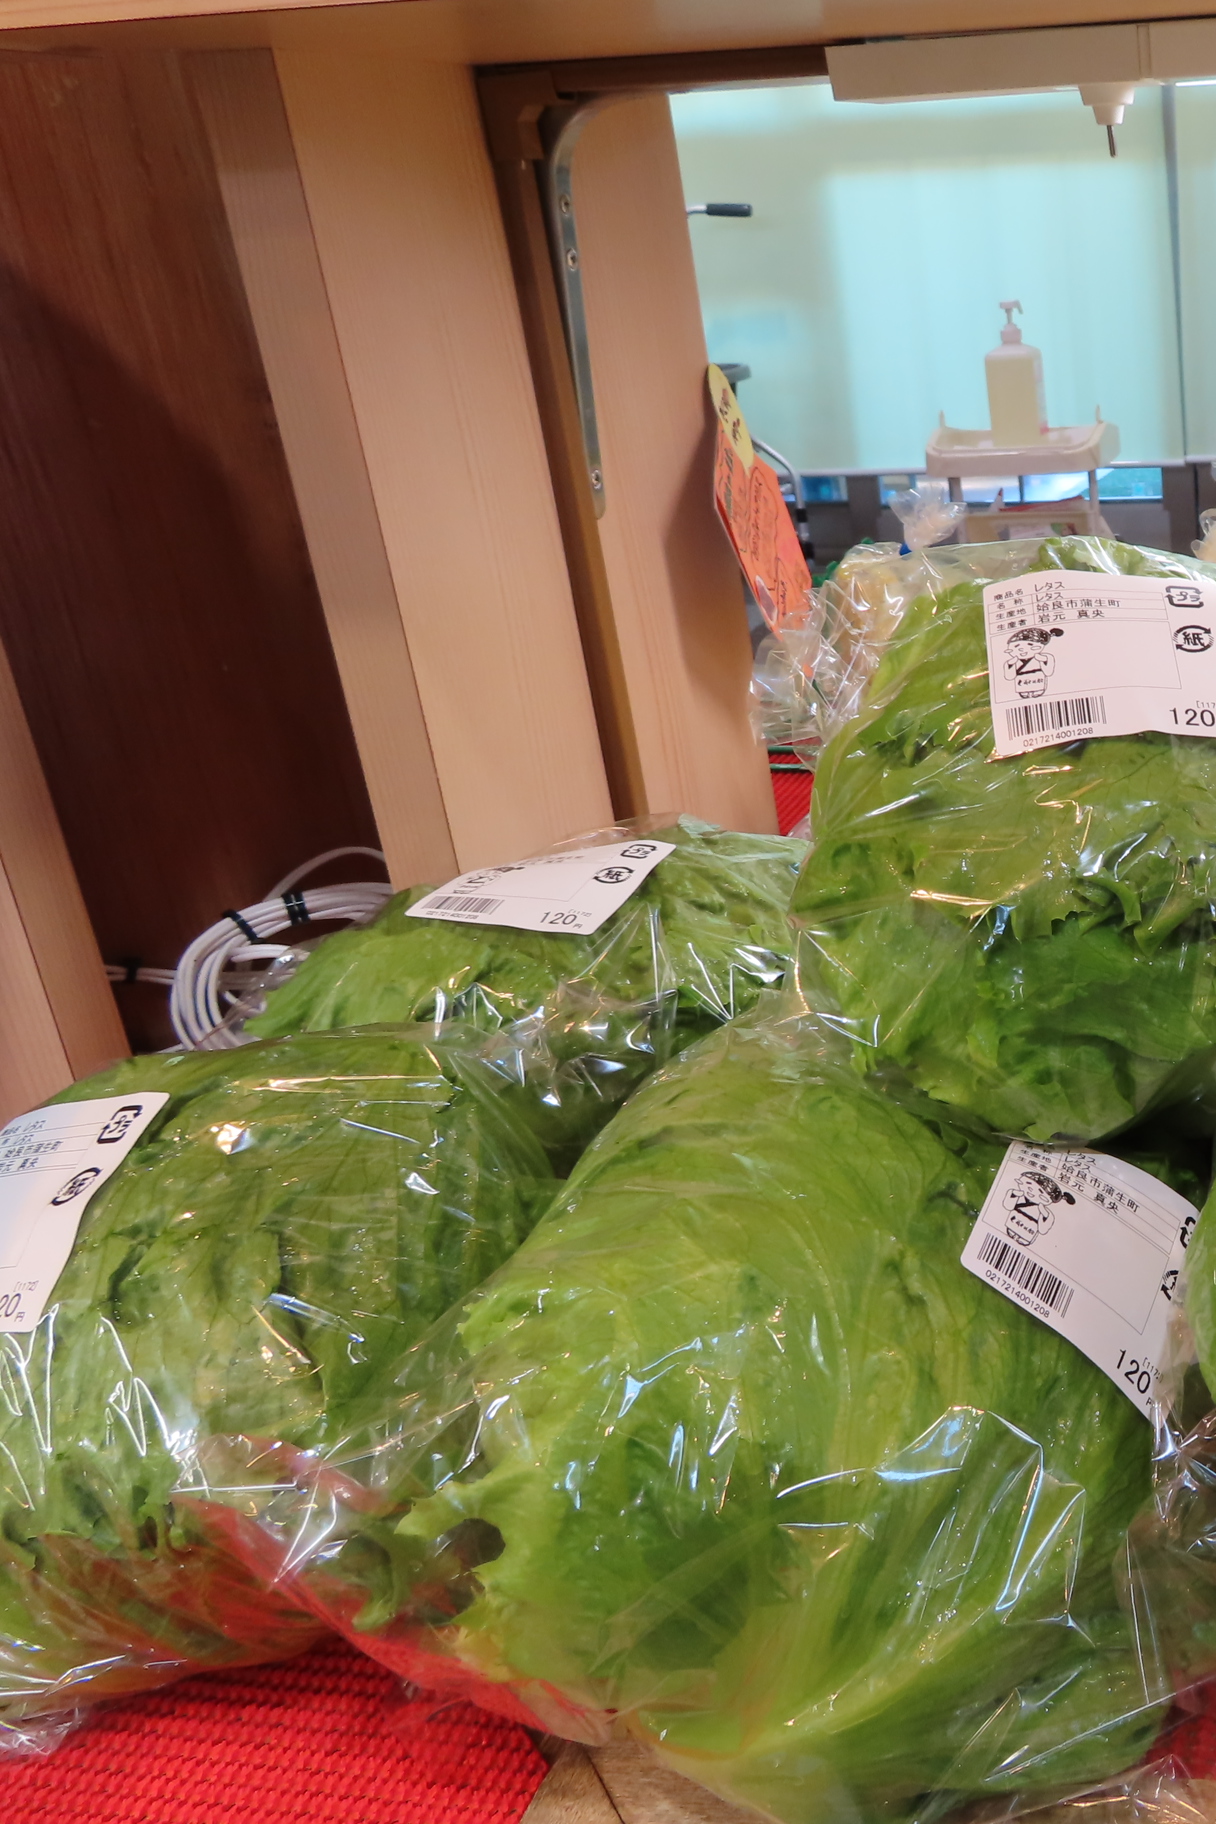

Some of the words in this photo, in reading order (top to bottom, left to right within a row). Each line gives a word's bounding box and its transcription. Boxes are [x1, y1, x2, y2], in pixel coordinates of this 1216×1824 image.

[993, 588, 1024, 601] 商品名
[1034, 581, 1065, 593] レタス
[1035, 591, 1064, 602] レタス
[995, 608, 1027, 620] 生産地
[996, 619, 1028, 632] 生産者
[1076, 608, 1105, 620] 真央
[1182, 631, 1205, 647] 紙
[1023, 727, 1094, 748] 0217214001208
[1017, 1156, 1049, 1172] 生産者
[1067, 1149, 1097, 1166] レタス
[1094, 1192, 1120, 1215] 真央
[985, 1269, 1051, 1319] 0217214001208
